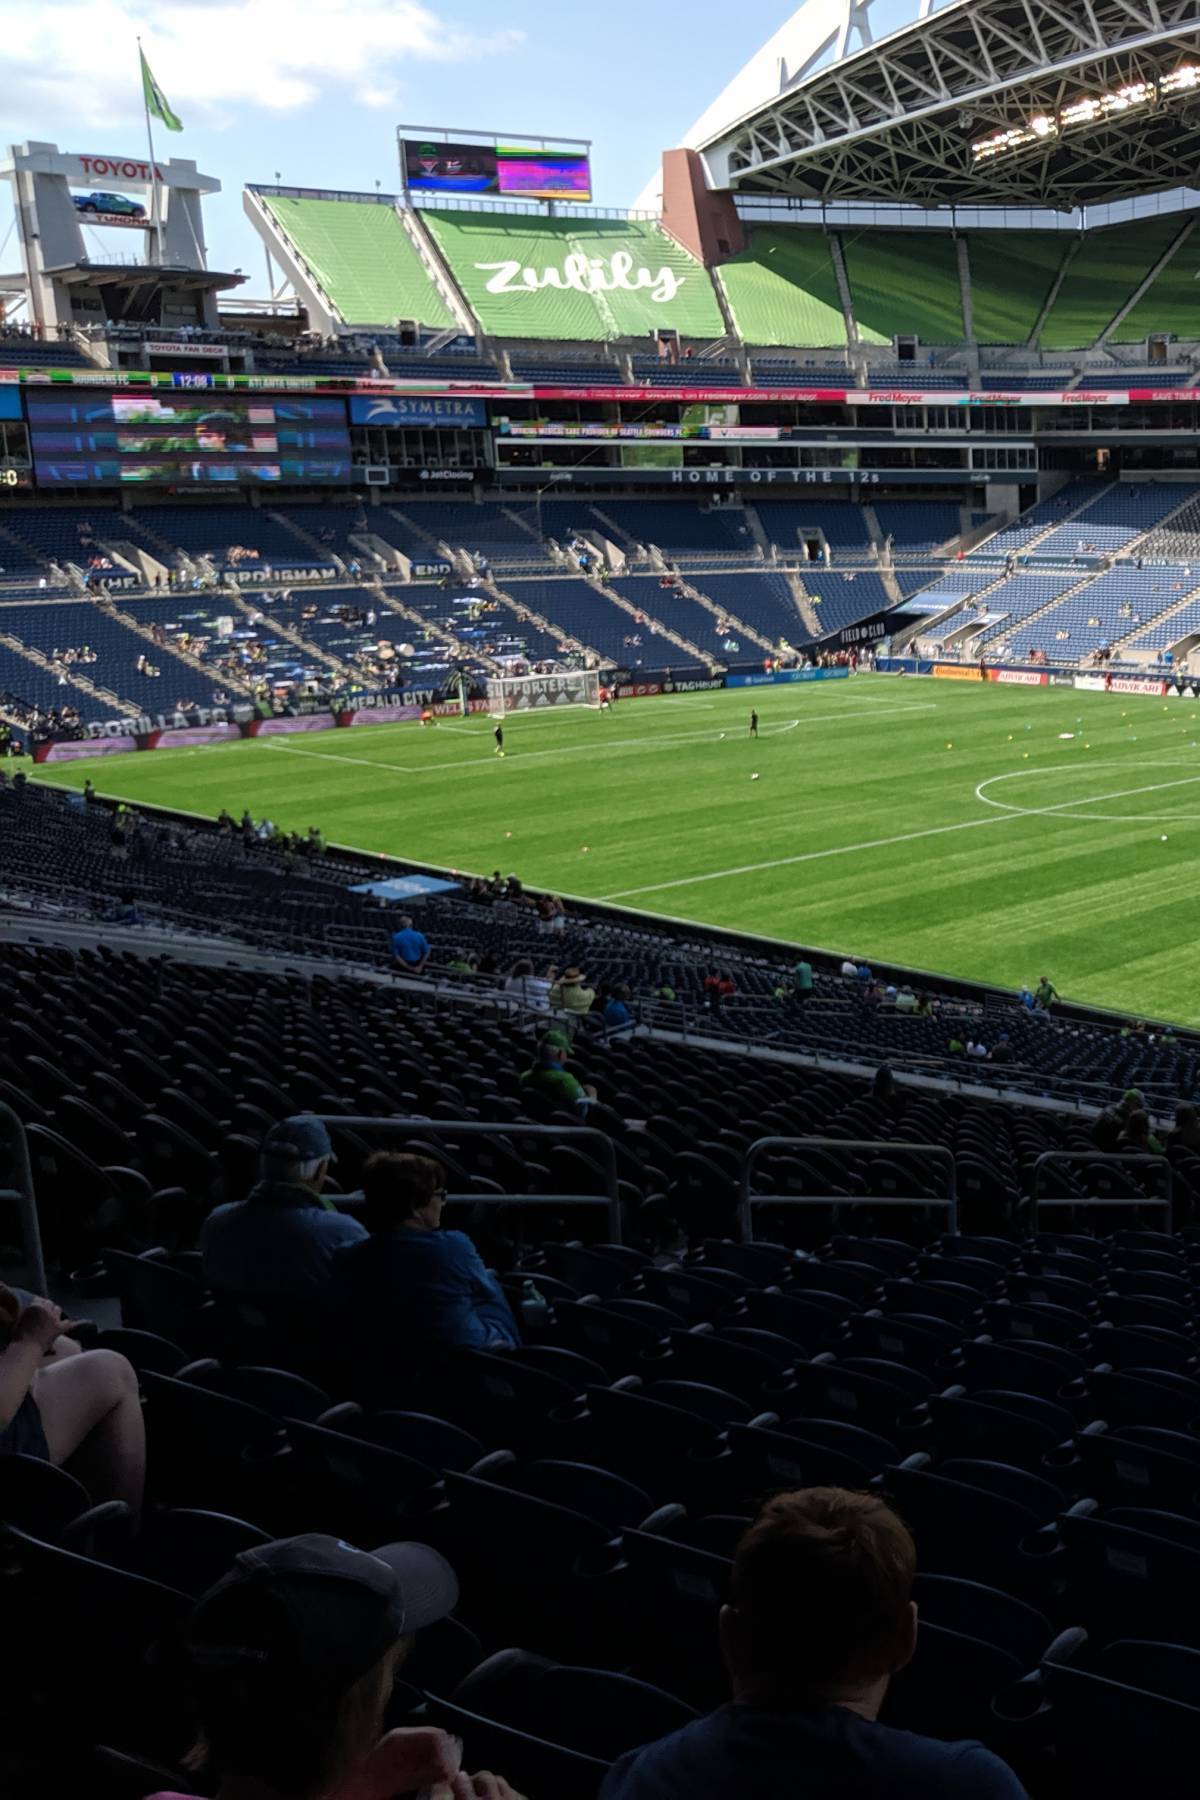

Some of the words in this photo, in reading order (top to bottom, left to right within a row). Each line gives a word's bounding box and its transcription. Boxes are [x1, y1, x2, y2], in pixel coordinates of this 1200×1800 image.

[80, 157, 164, 181] TOYOTA
[399, 400, 474, 415] SYMETRA
[431, 470, 474, 480] JetClosing
[672, 471, 734, 482] HOME
[752, 471, 777, 482] OF
[793, 472, 832, 482] THE
[849, 472, 879, 483] 12s
[416, 565, 450, 575] END
[841, 628, 860, 644] FIELD
[868, 623, 886, 638] CLUB
[487, 677, 576, 697] SUPPORTERS
[403, 690, 433, 706] CITY
[89, 712, 190, 738] GORILLA
